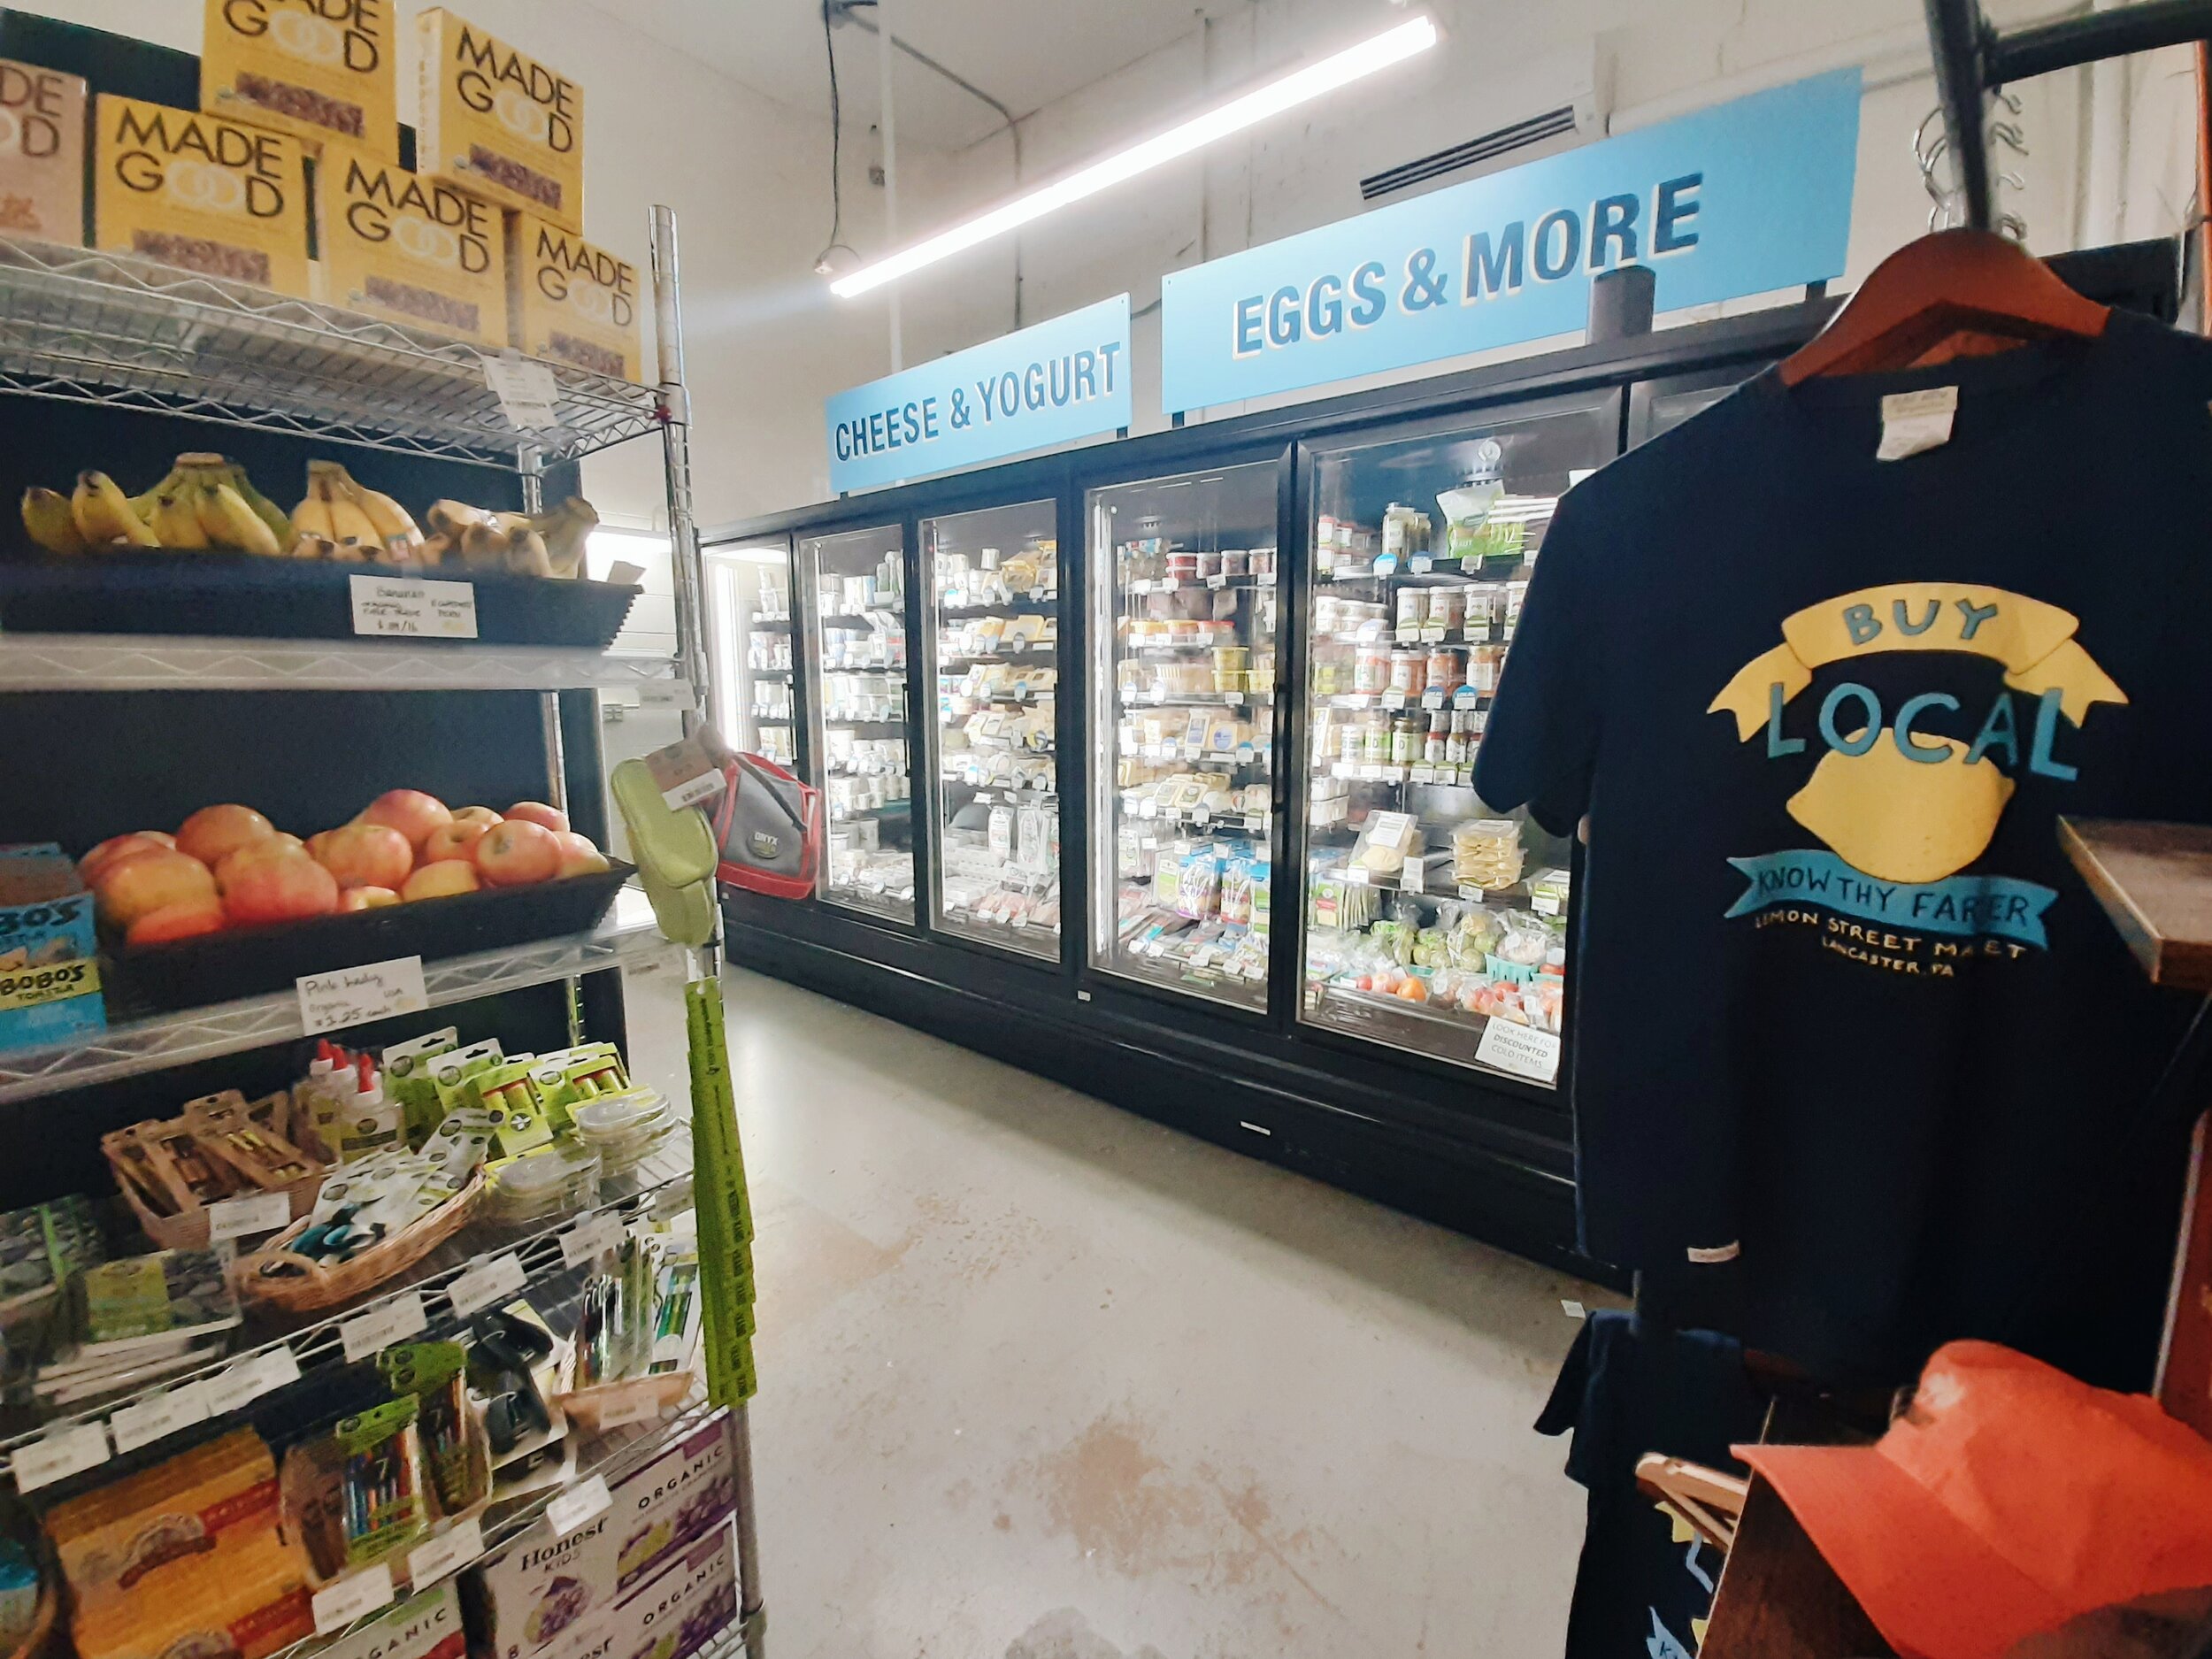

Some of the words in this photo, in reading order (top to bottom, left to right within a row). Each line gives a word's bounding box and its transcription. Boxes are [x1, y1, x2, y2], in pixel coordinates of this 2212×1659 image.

[457, 27, 573, 120] MADE
[116, 106, 282, 180] MADE
[457, 70, 572, 153] GOOD
[115, 150, 284, 218] GOOD
[346, 158, 488, 240] MADE
[346, 201, 489, 273] GOOD
[537, 227, 633, 297] MADE
[1233, 262, 1386, 360] EGGS
[1400, 247, 1448, 316] &
[1461, 172, 1703, 307] MORE
[538, 266, 633, 326] GOOD
[835, 396, 940, 463] CHEESE
[949, 388, 972, 430] &
[975, 342, 1121, 426] YOGURT
[1841, 597, 2000, 647] BUY
[1766, 681, 2078, 782] LOCAL
[1758, 867, 1831, 895] KNOW
[1837, 877, 1897, 913] THY
[1911, 892, 2030, 926] FARER
[1827, 917, 1922, 952] STREET
[1933, 939, 2027, 959] MAET
[1932, 963, 1955, 977] PA
[1491, 1044, 1515, 1058] COLD
[1516, 1053, 1543, 1069] ITEMS
[1494, 1033, 1548, 1058] DISCOUNTED
[1517, 1030, 1539, 1045] HERE
[637, 1444, 723, 1510] ORGANIC
[521, 1516, 609, 1572] Honest
[642, 1553, 726, 1626] ORGANIC
[368, 1606, 448, 1659] GANIC
